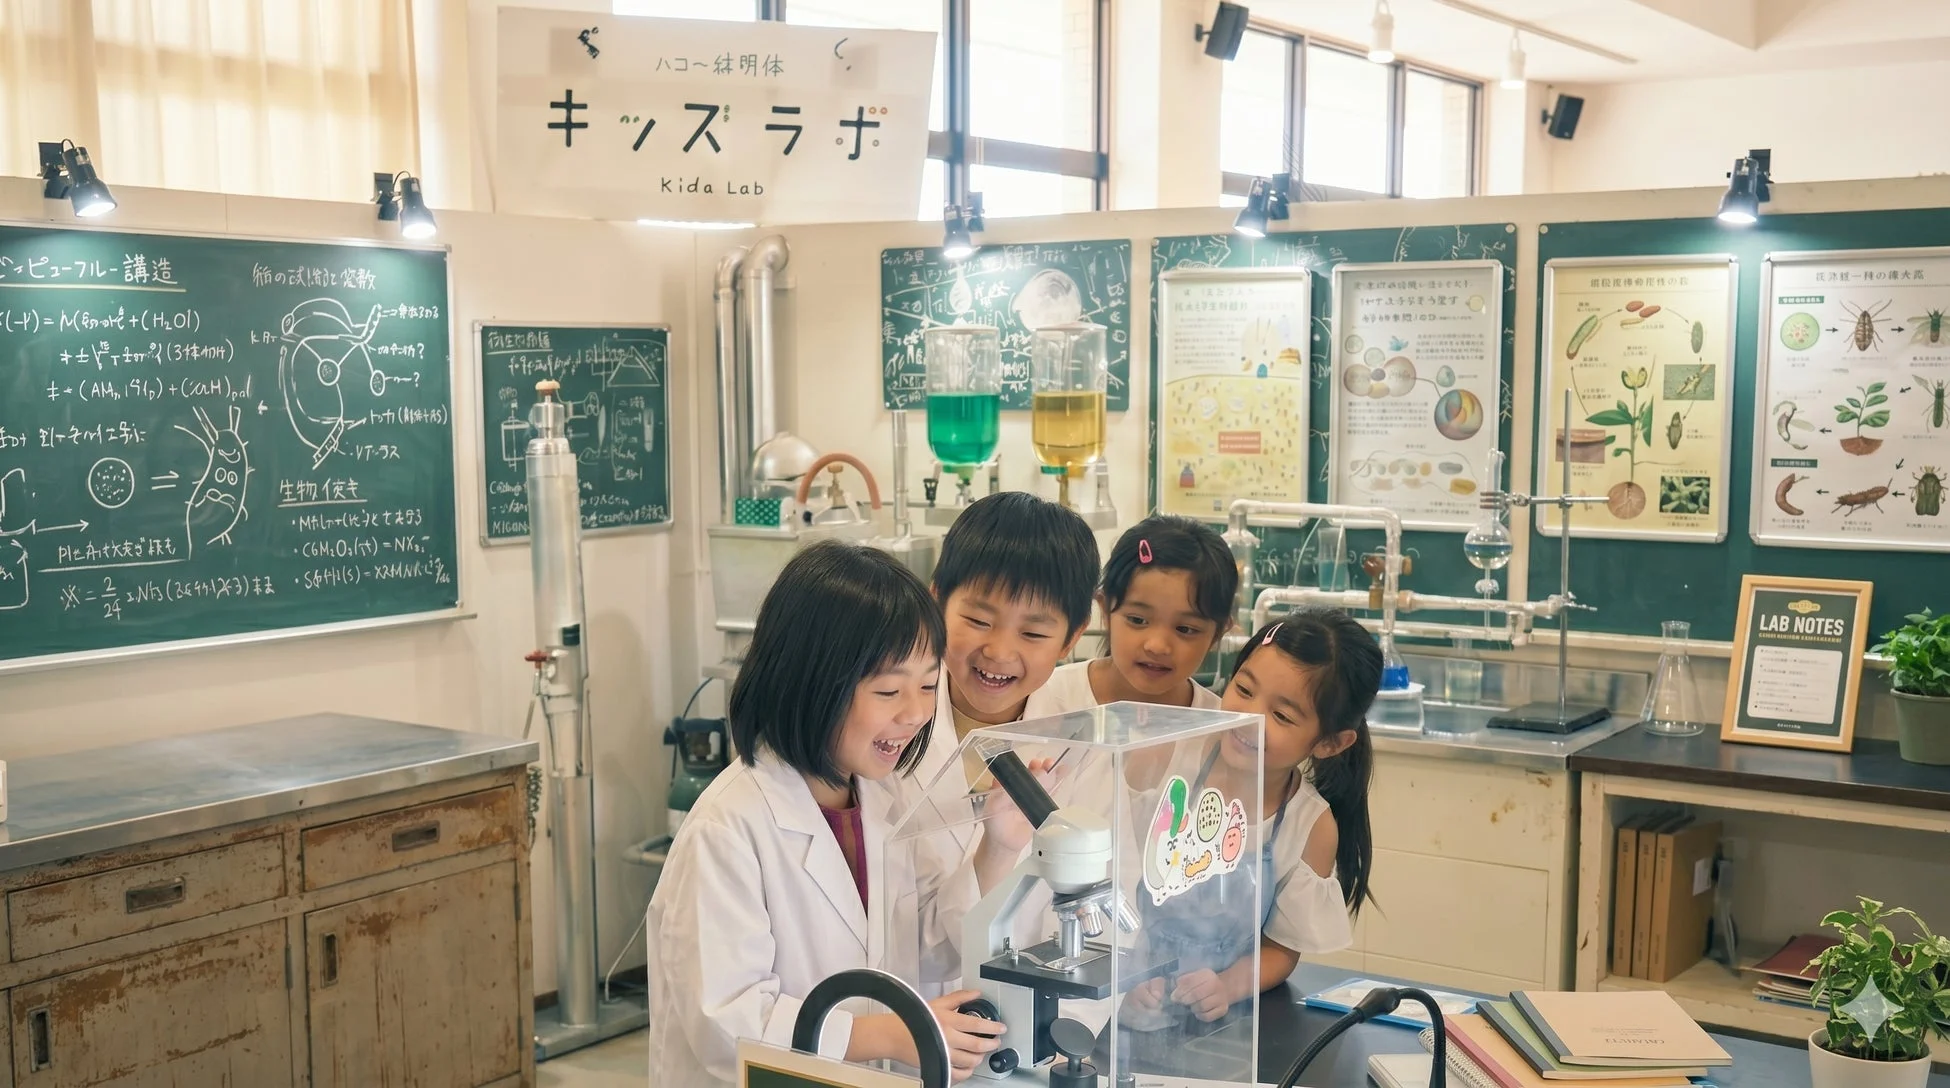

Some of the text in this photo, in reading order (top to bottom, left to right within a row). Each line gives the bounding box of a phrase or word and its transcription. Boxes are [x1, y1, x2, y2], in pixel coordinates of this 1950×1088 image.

[661, 177, 764, 196] Kida Lab
[1760, 614, 1844, 636] LAB NOTES
